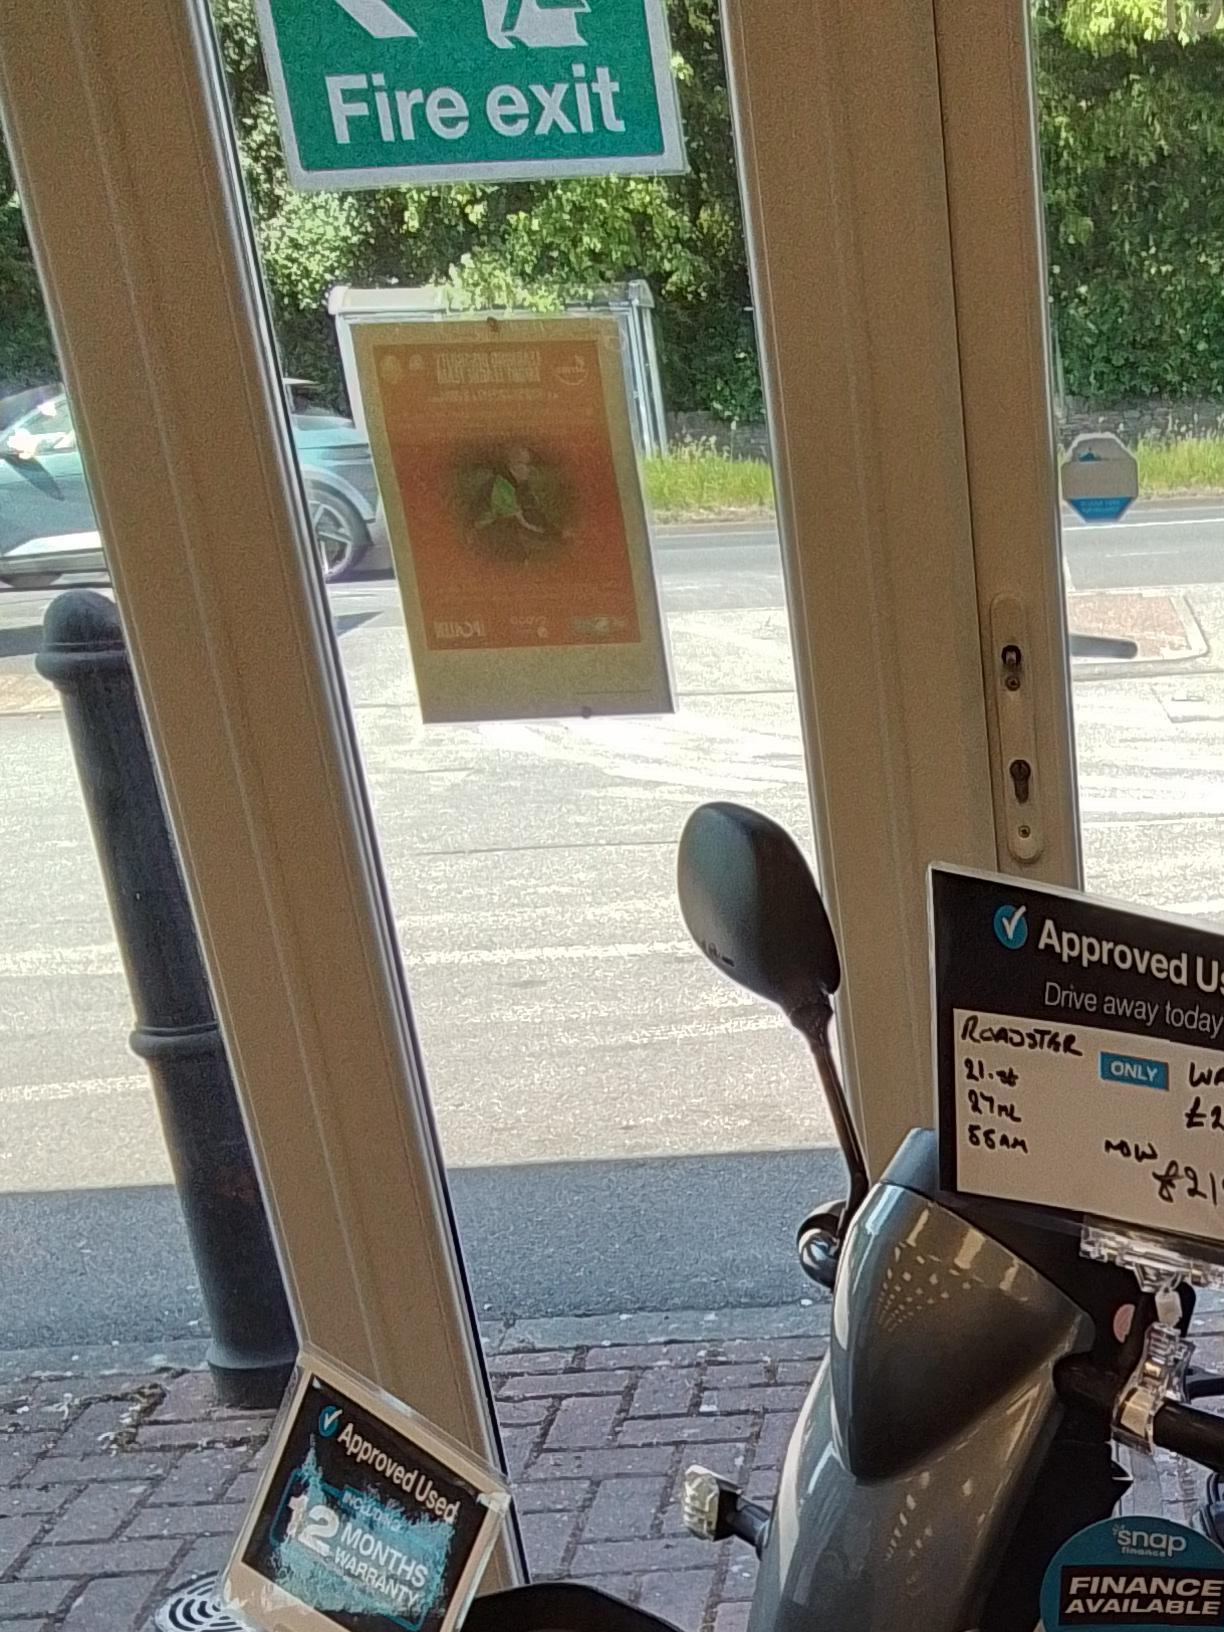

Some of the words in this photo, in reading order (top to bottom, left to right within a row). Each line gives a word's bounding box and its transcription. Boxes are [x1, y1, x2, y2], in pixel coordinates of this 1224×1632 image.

[325, 73, 469, 145] Fire
[487, 64, 625, 138] exit
[1037, 918, 1188, 986] Approved
[1044, 981, 1098, 1012] Drive
[1103, 994, 1160, 1027] away
[1165, 998, 1224, 1040] today
[1110, 1060, 1159, 1083] ONLY
[337, 1422, 418, 1493] Approved
[414, 1474, 461, 1524] Used
[286, 1494, 340, 1558] 12
[341, 1522, 429, 1588] MONTHS
[1117, 1529, 1187, 1557] snap
[1121, 1546, 1166, 1557] finance
[333, 1546, 420, 1608] WARRANTY
[1064, 1598, 1221, 1616] AVAILABLE
[1069, 1576, 1224, 1597] FINANCE
